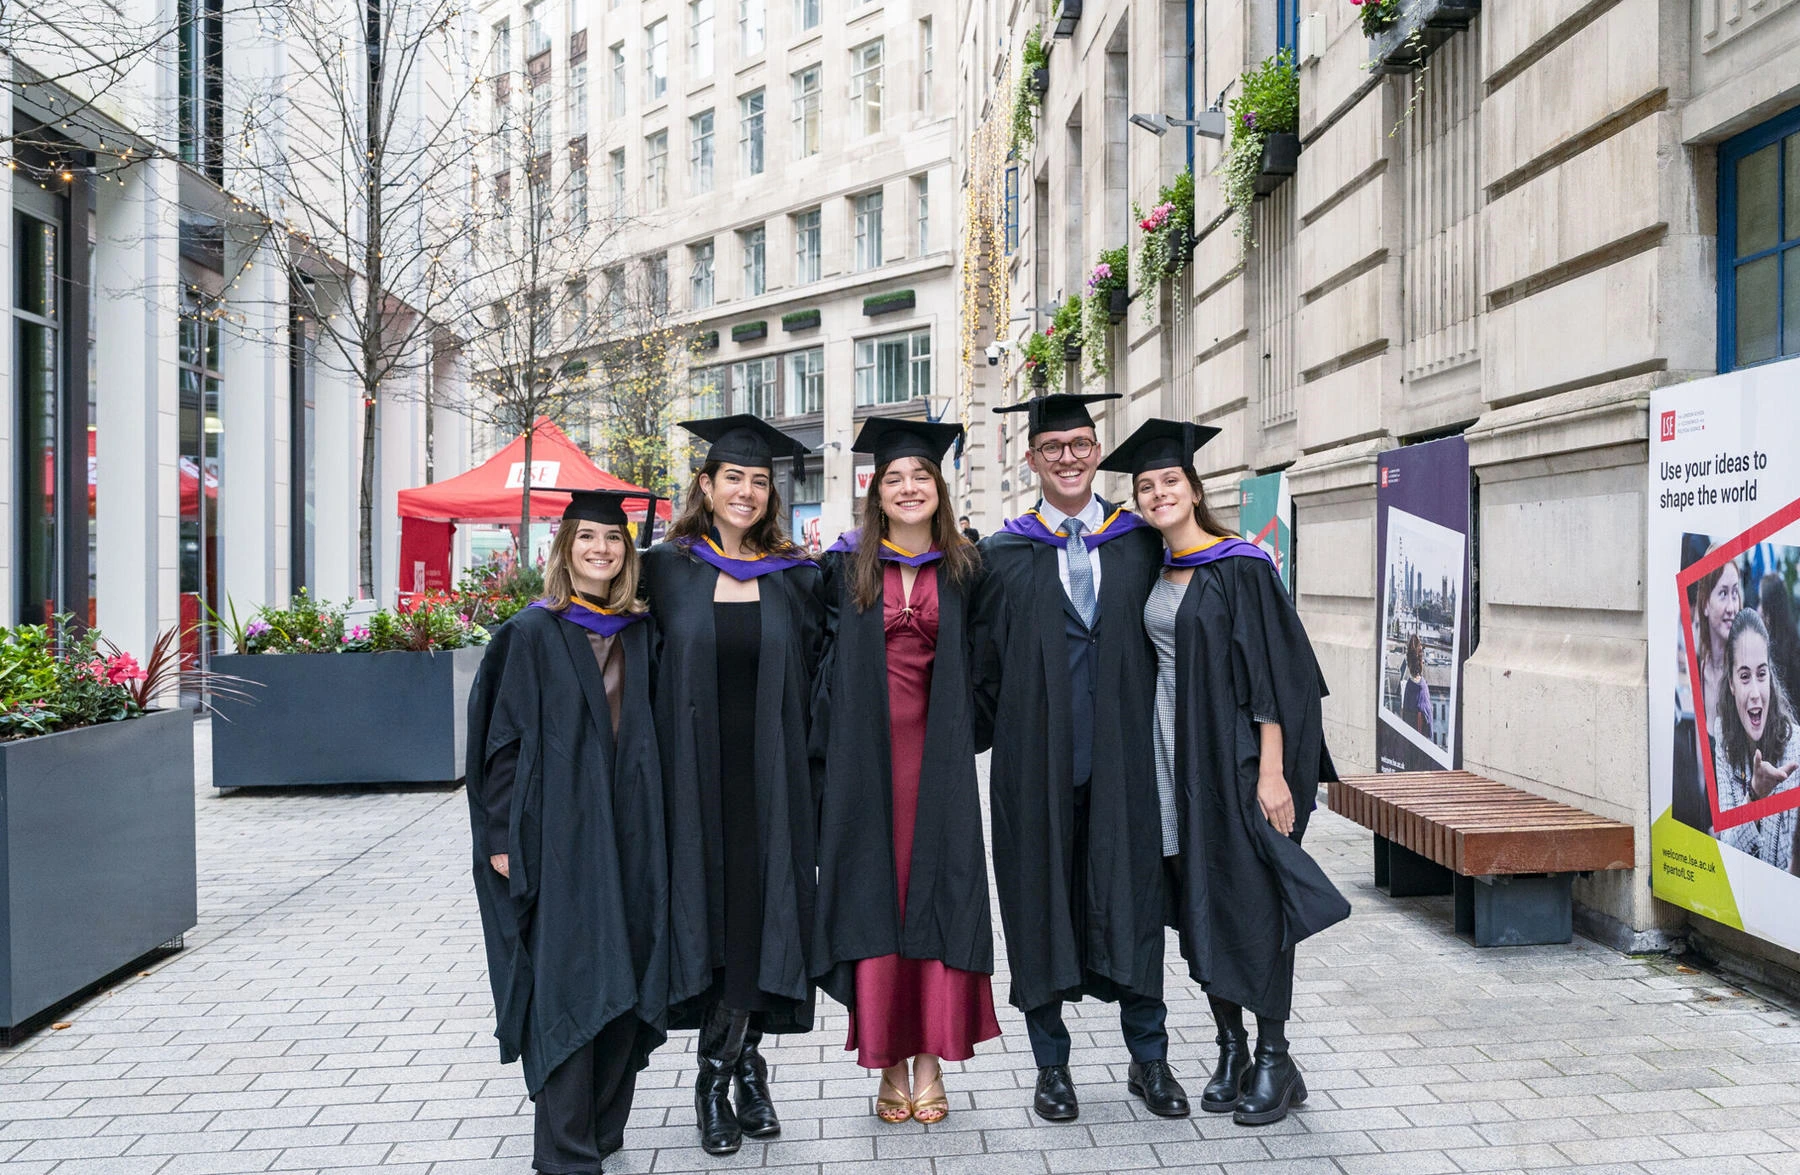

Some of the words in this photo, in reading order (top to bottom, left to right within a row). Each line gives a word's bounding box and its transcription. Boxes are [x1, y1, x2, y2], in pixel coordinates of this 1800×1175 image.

[1662, 415, 1674, 437] LSE
[1660, 461, 1682, 481] Use
[1685, 459, 1712, 484] your
[1715, 452, 1750, 475] ideas
[1753, 450, 1767, 470] to
[1660, 488, 1695, 512] shape
[1697, 484, 1717, 506] the
[1721, 478, 1757, 503] world
[1662, 848, 1716, 874] welcome.lse.ac.uk
[1663, 862, 1695, 883] #partofLSE
